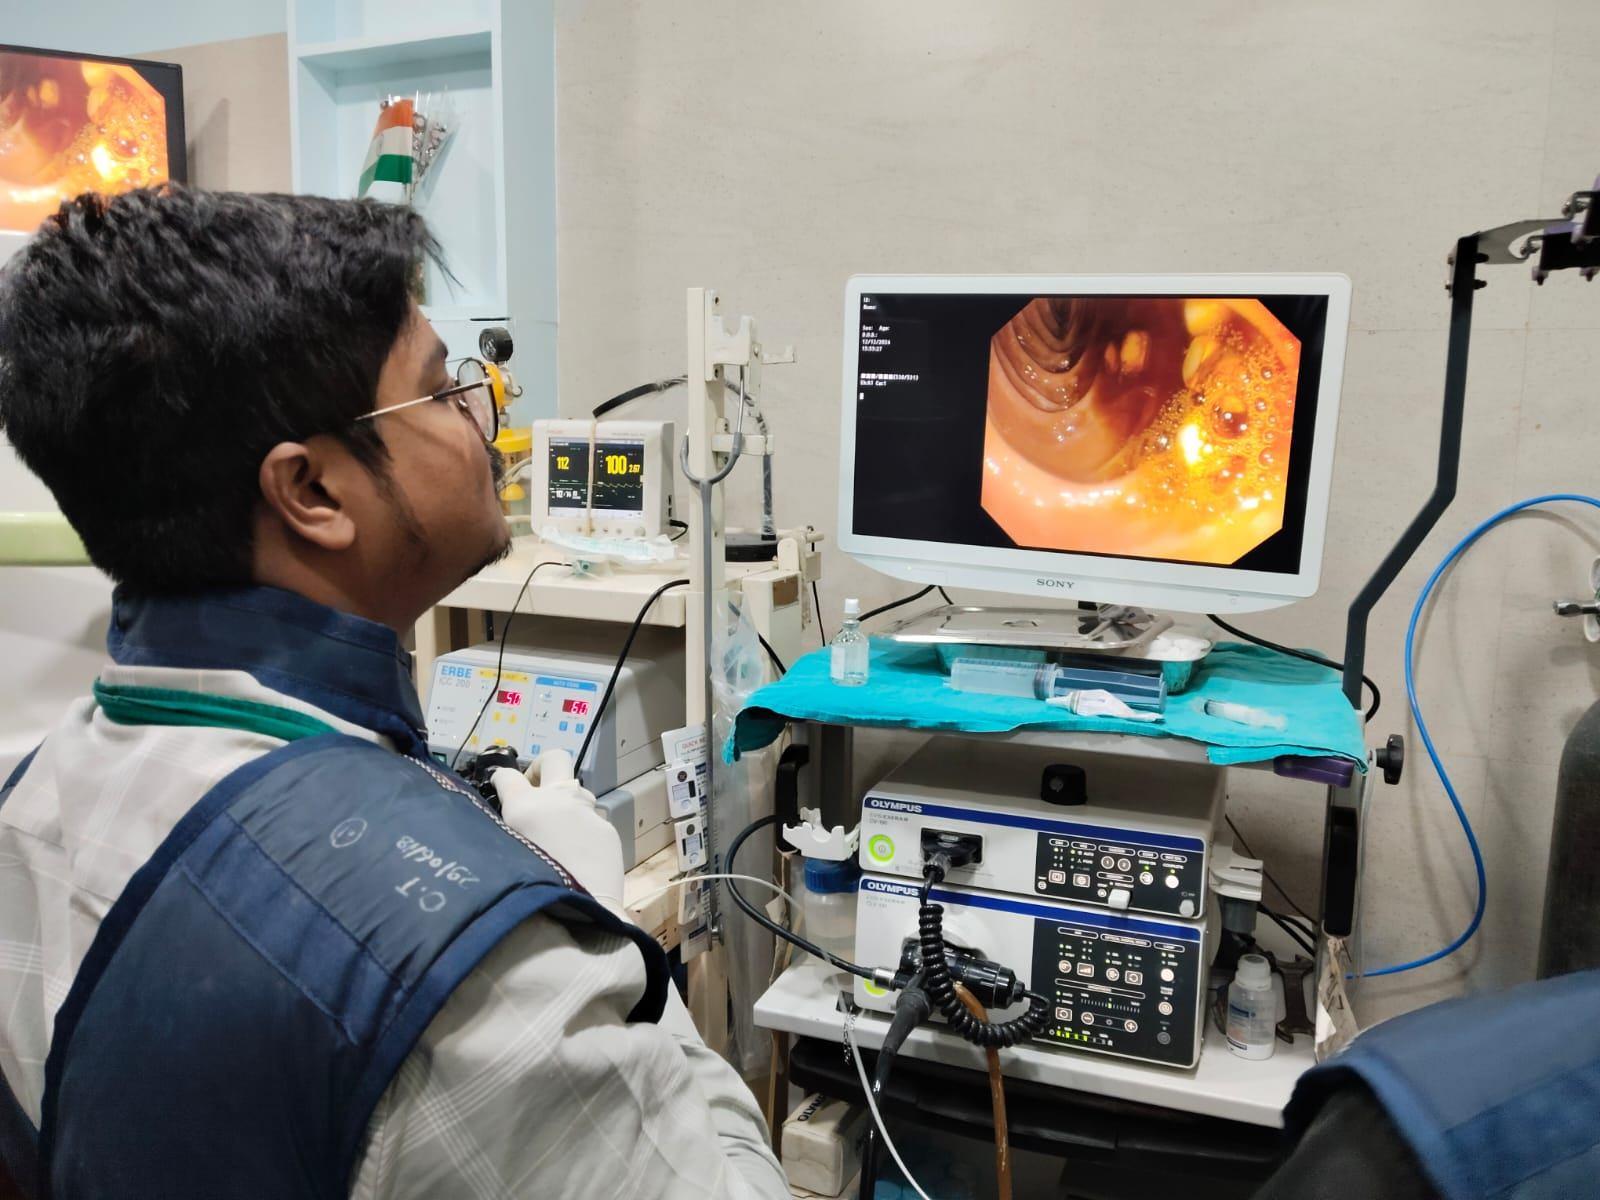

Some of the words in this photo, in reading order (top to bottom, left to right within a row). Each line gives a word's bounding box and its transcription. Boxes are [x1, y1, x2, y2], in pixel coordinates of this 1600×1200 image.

[556, 456, 570, 469] 112
[605, 455, 628, 475] 100
[1036, 578, 1075, 588] SONY
[441, 665, 472, 680] ERBE
[506, 692, 522, 706] 50
[571, 701, 588, 715] 60
[871, 800, 922, 813] OLYMPUS
[867, 882, 919, 897] OLYMPUS
